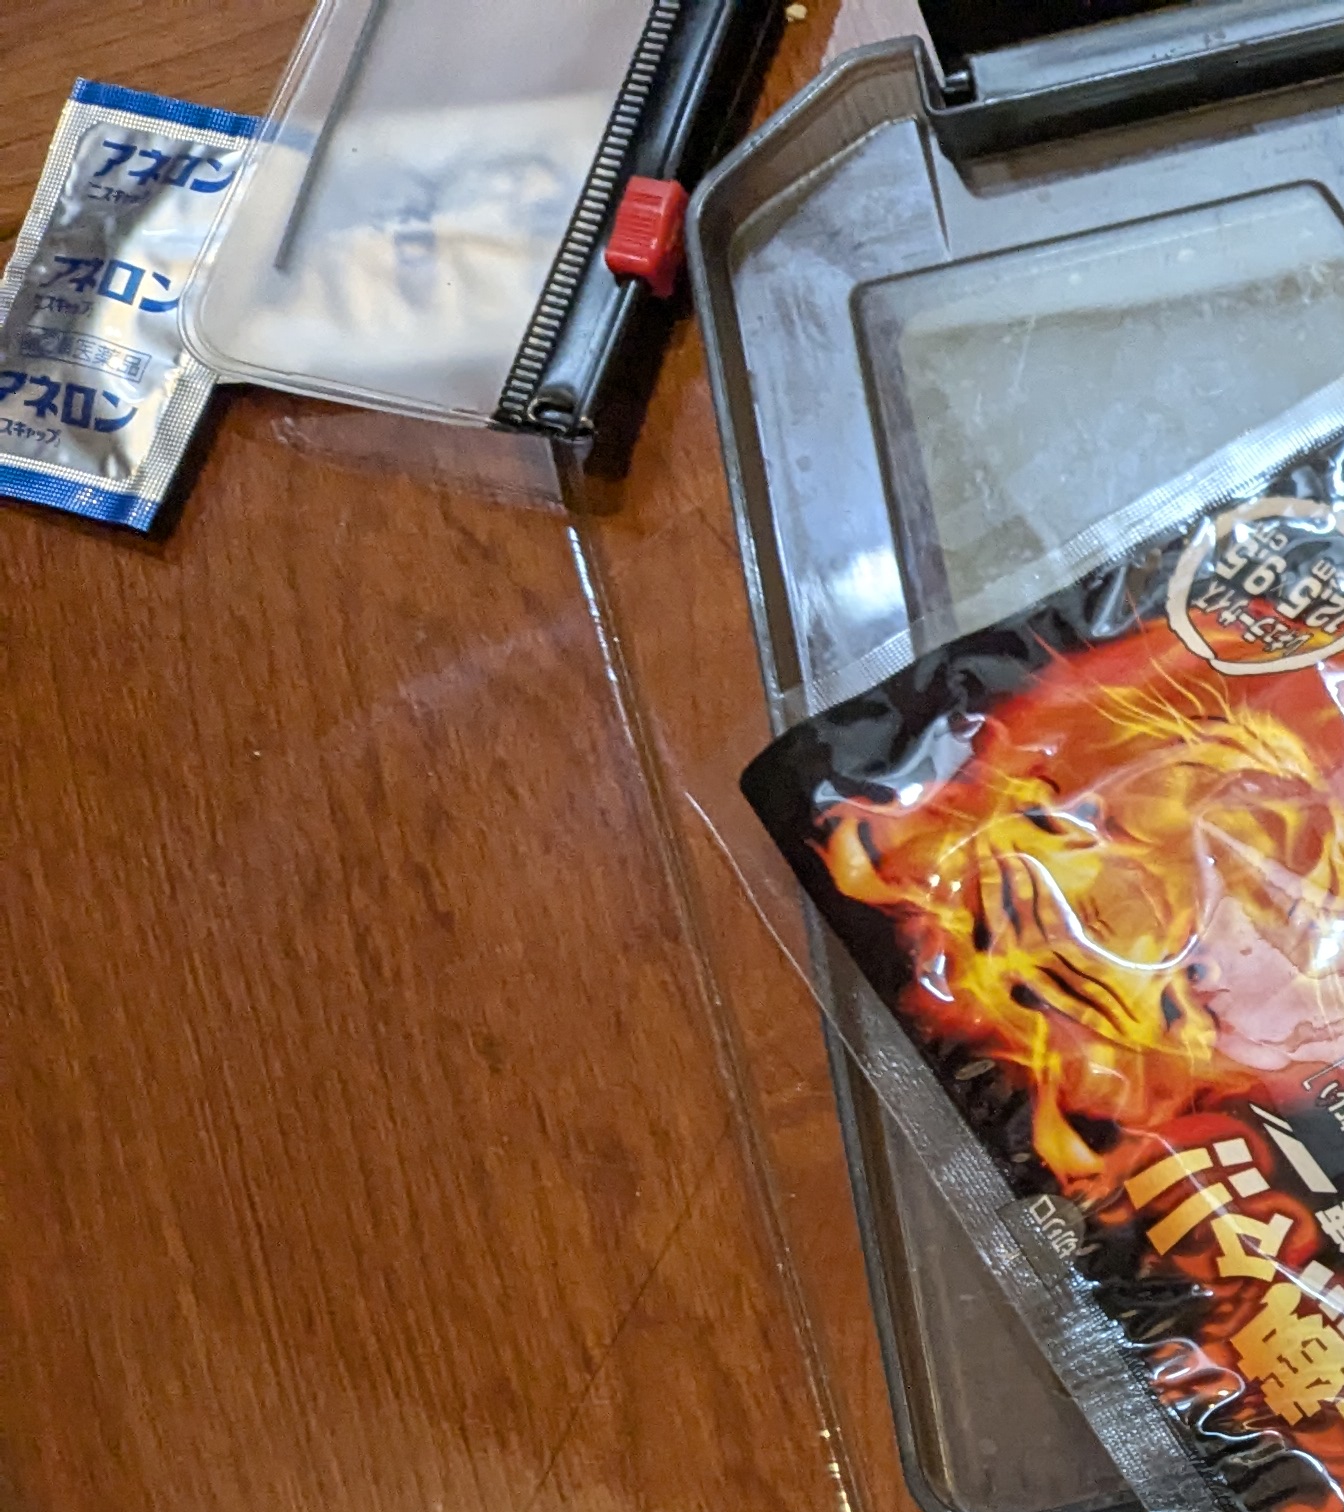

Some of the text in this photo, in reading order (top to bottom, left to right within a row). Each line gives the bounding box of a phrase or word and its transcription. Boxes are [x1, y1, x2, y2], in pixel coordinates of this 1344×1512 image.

[93, 140, 237, 193] アネロン
[40, 256, 182, 312] アネロン
